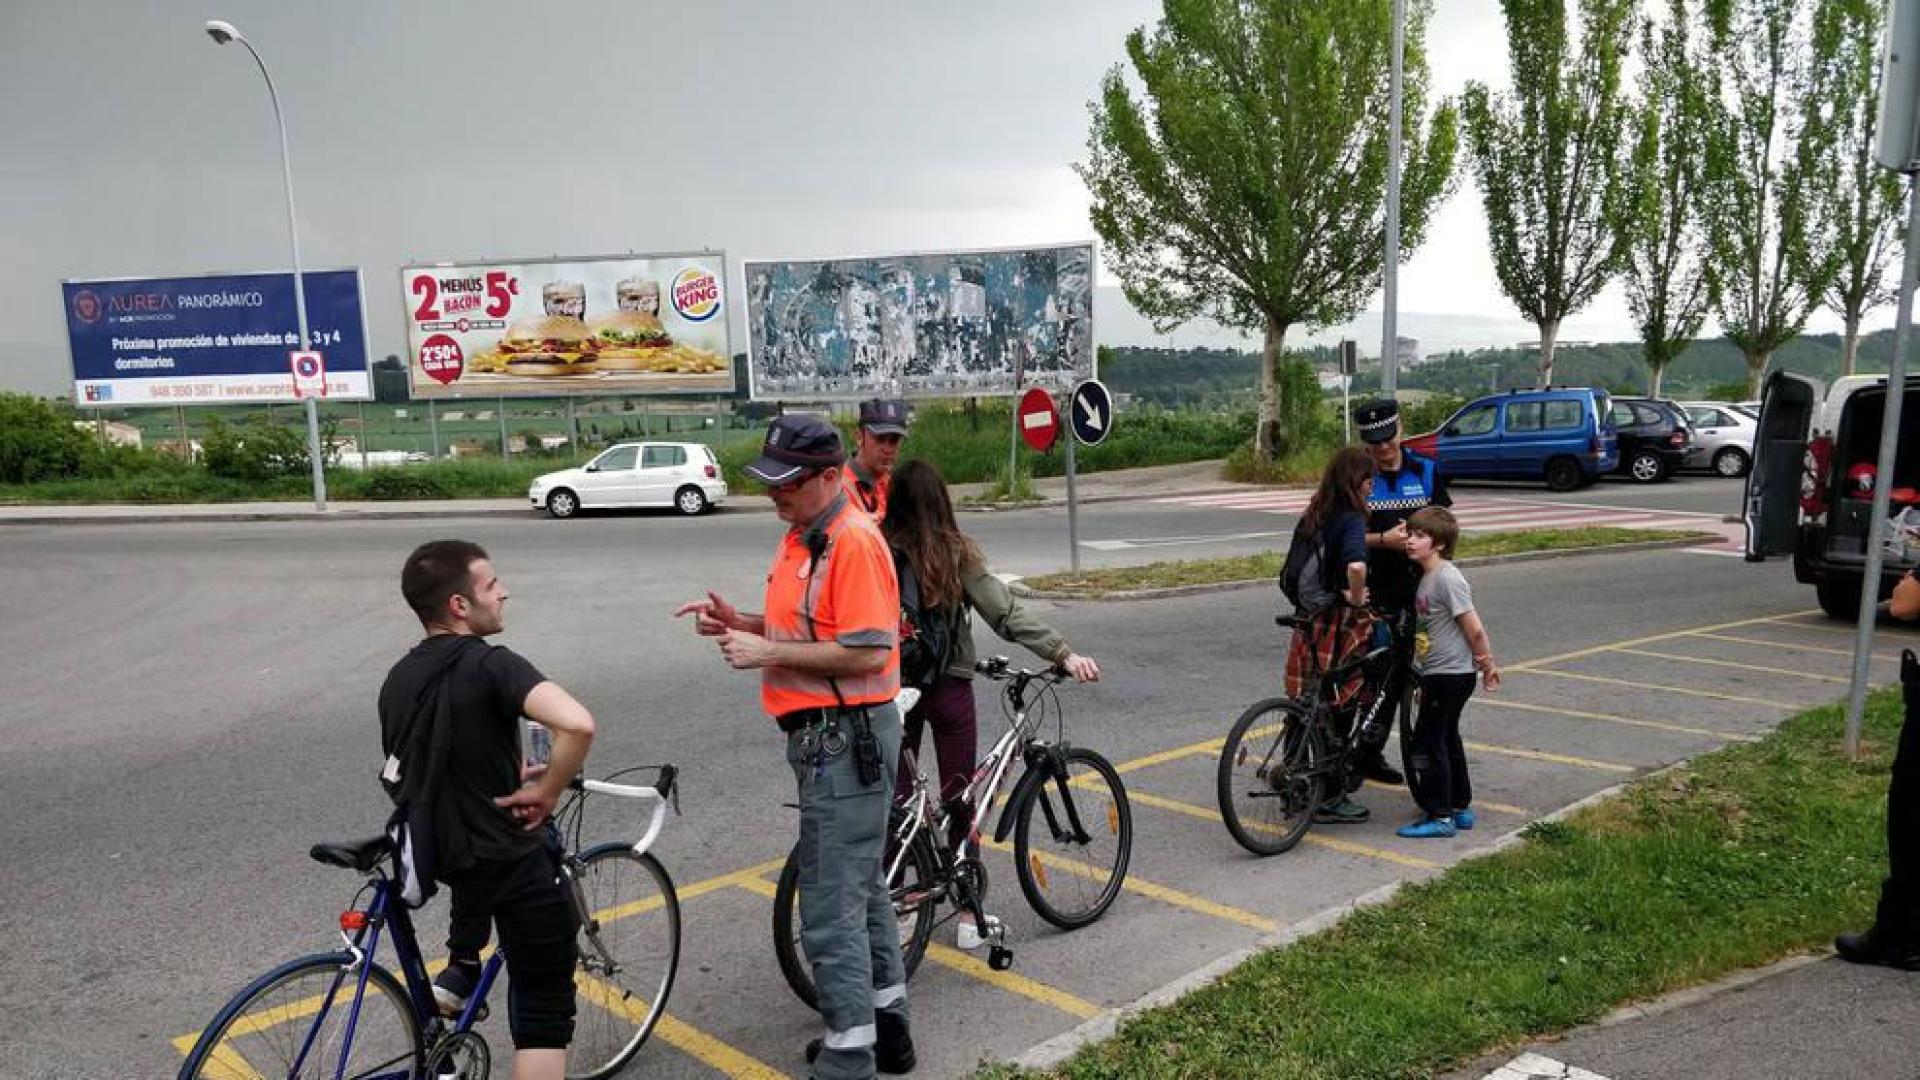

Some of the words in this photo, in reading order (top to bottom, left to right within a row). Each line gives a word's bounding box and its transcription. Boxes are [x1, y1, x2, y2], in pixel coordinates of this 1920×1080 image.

[412, 274, 440, 320] 2
[676, 276, 717, 297] BURGER
[108, 294, 174, 311] AUREA
[678, 288, 718, 311] KING
[156, 334, 213, 351] promoción
[215, 332, 229, 346] de
[230, 332, 282, 346] viviendas
[284, 331, 299, 345] de
[313, 330, 321, 344] 3
[323, 332, 331, 346] y
[332, 328, 341, 343] 4
[114, 355, 175, 371] dormitorios
